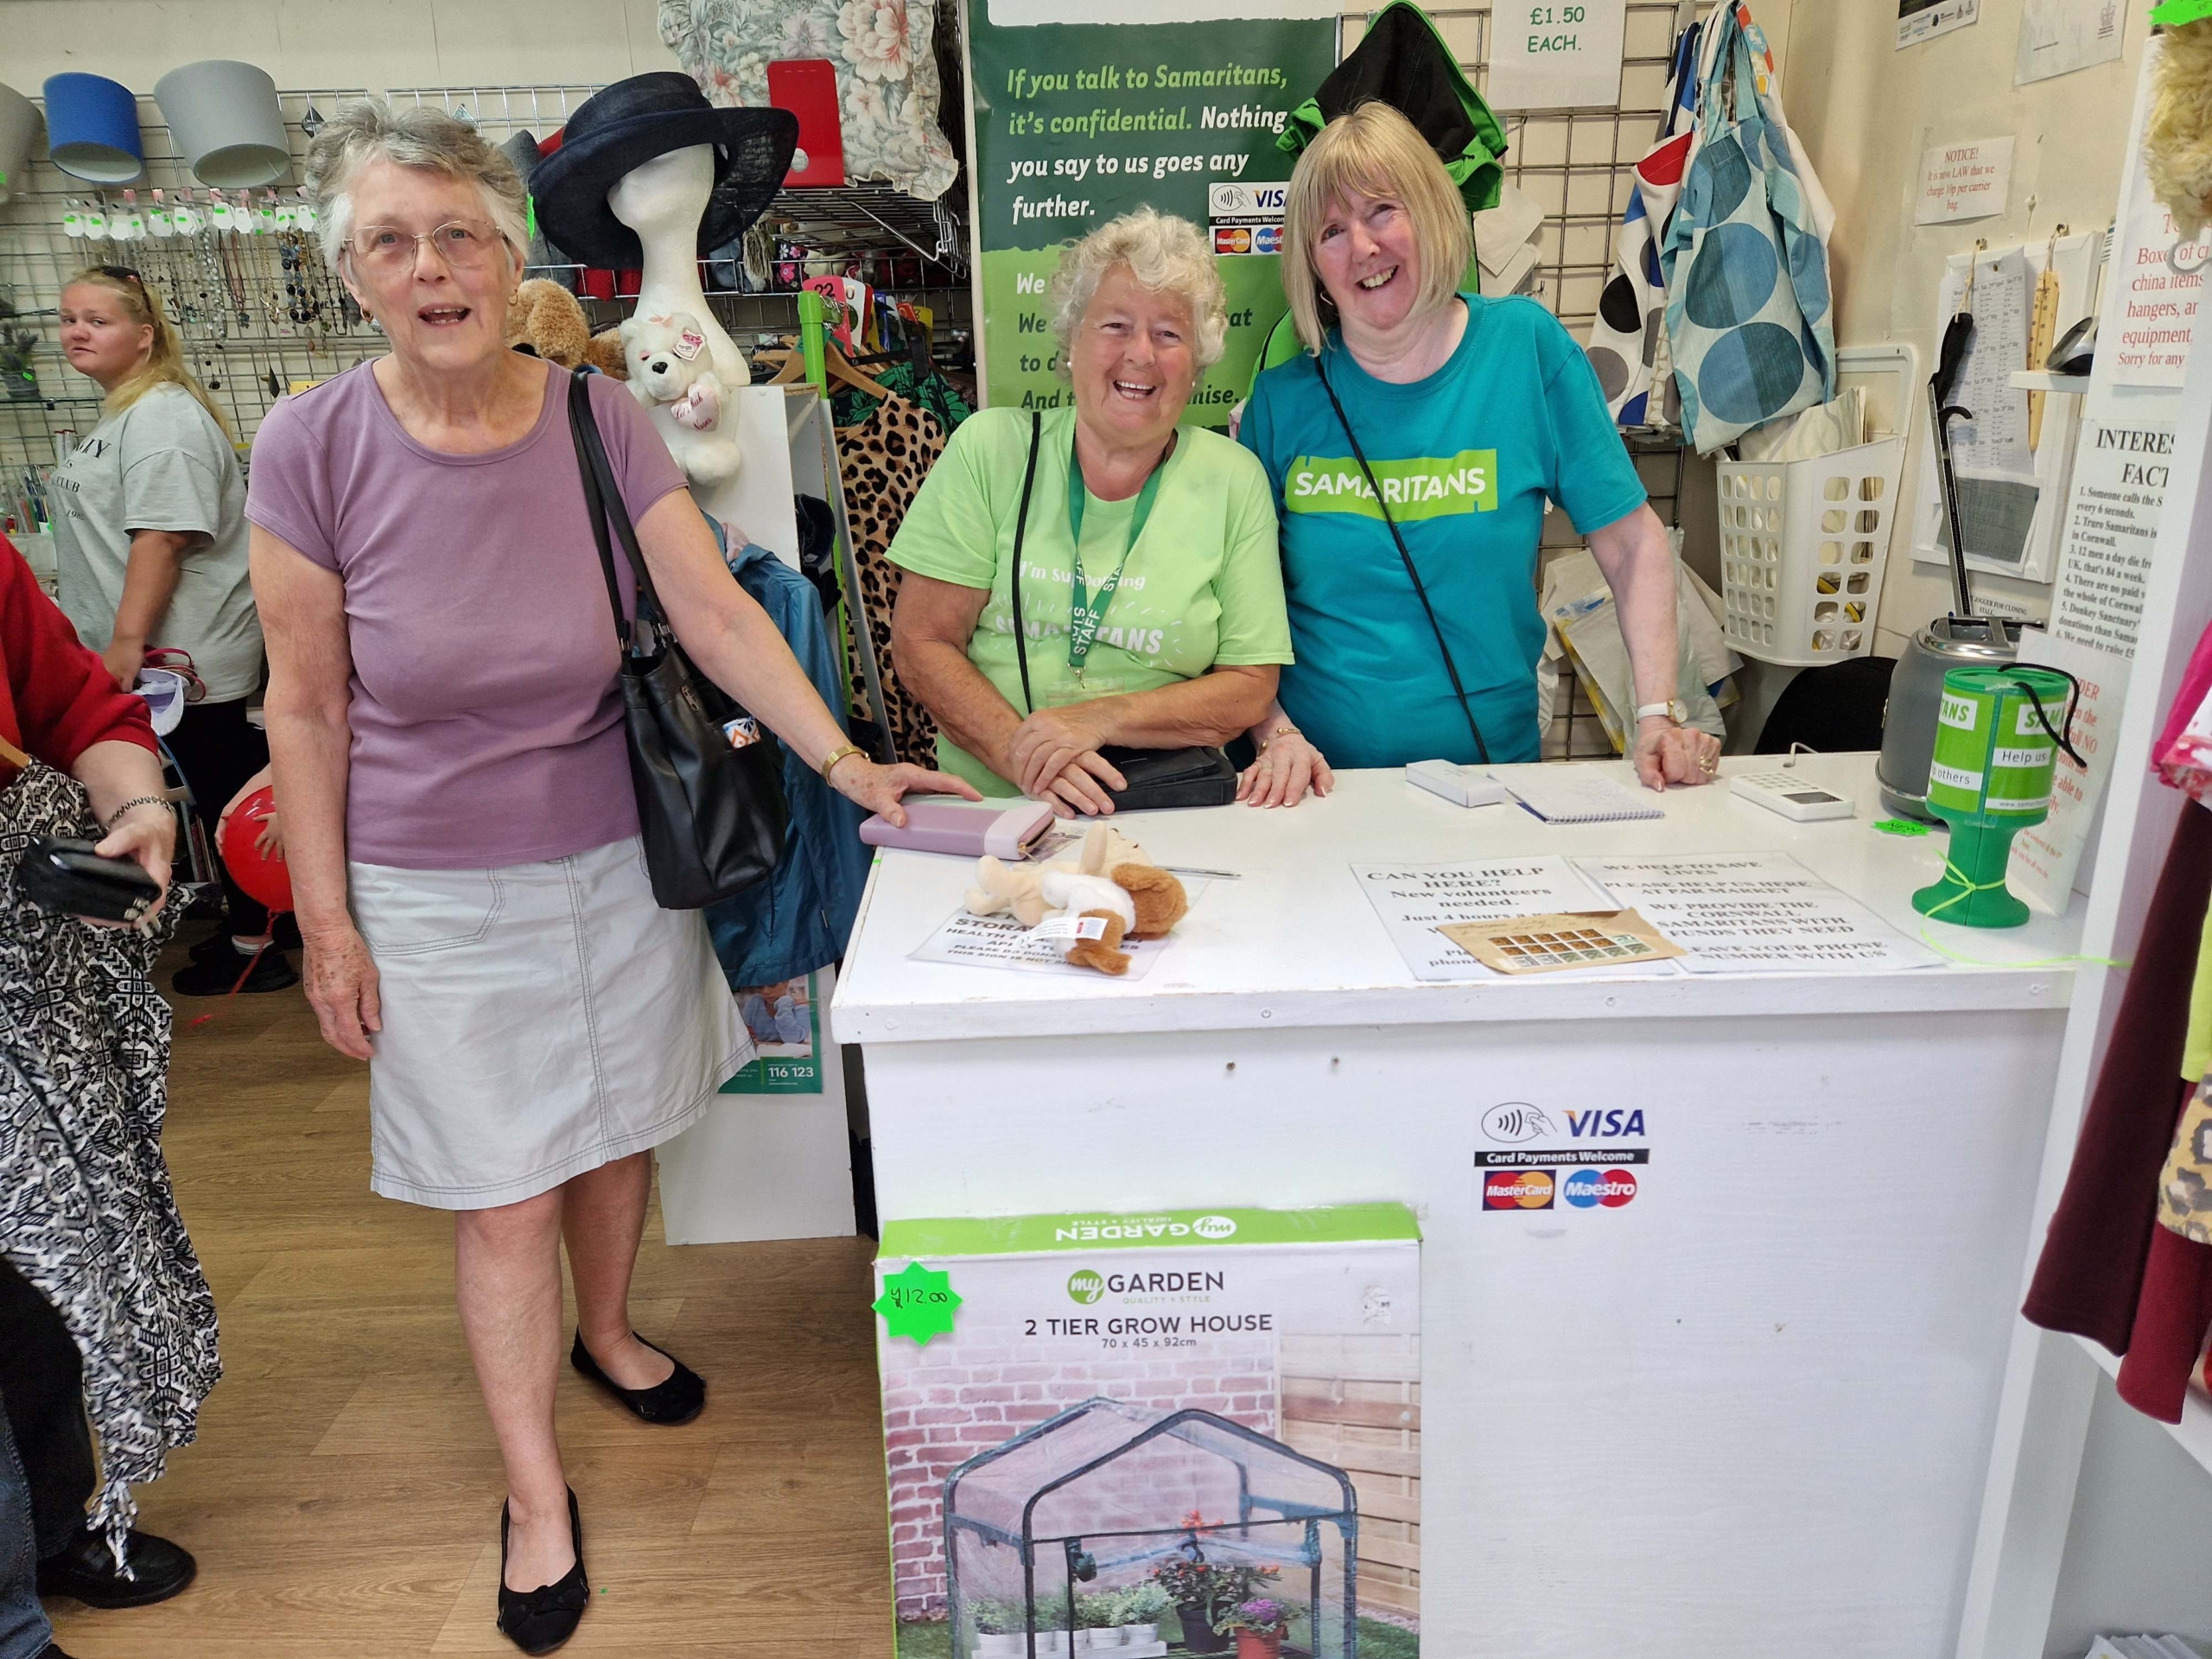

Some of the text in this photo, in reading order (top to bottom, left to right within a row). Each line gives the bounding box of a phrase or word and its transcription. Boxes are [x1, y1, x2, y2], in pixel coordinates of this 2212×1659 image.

[1529, 6, 1585, 25] £1.50
[1528, 35, 1582, 53] EACH.
[1007, 62, 1287, 99] If you talk to Samaritans,
[1009, 105, 1287, 138] it’s confidential. Nothing
[1945, 147, 1980, 162] NOTICE!
[1007, 154, 1249, 184] you say to us goes any
[1952, 166, 1970, 178] LAW
[1970, 164, 1983, 176] that
[1253, 190, 1287, 207] VIS
[1012, 194, 1096, 225] further.
[1231, 216, 1262, 225] Payments
[1217, 237, 1249, 245] MasterCard
[1016, 272, 1045, 294] We
[2132, 274, 2165, 291] china
[2127, 301, 2180, 321] hangers,
[1019, 313, 1046, 334] We
[1020, 355, 1040, 372] to
[2118, 351, 2184, 368] Sorry for any
[1020, 389, 1061, 410] And
[1294, 468, 1485, 503] SAMARITANS
[2088, 487, 2121, 500] Someone
[2123, 493, 2140, 504] calls
[2142, 495, 2155, 505] the
[2076, 503, 2096, 515] every
[2104, 508, 2135, 518] seconds.
[2083, 517, 2104, 529] Truro
[2105, 521, 2149, 537] Samaritans
[2088, 550, 2104, 560] men
[2112, 553, 2126, 566] day
[2127, 556, 2140, 567] die
[2074, 575, 2094, 588] There
[2063, 588, 2075, 598] the
[2076, 592, 2097, 604] whole
[1073, 609, 1100, 655] STAFF
[2002, 752, 2046, 765] Help us
[1938, 770, 1970, 785] others
[1367, 867, 1544, 881] CAN YOU HELP
[1391, 887, 1552, 899] New volunteers
[1423, 880, 1502, 889] HERE?
[1439, 899, 1519, 909] needed.
[1402, 914, 1438, 923] Just
[1459, 912, 1511, 921] hours
[945, 928, 1006, 938] HEALTH
[1732, 928, 1796, 937] THEY
[768, 1067, 788, 1077] 116
[791, 1067, 814, 1077] 123
[1561, 1109, 1646, 1137] VISA
[1487, 1150, 1635, 1166] Card Payments Welcome
[1486, 1181, 1636, 1197] MasterCard Maestro
[1055, 1223, 1191, 1242] GARDEN
[1071, 1271, 1224, 1303] my GARDEN
[1122, 1296, 1166, 1305] QUALITY
[1025, 1314, 1273, 1336] 2 TIER GROW HOUSE
[1102, 1338, 1117, 1349] 70
[1133, 1338, 1149, 1348] 45
[1164, 1338, 1197, 1347] 92cm
